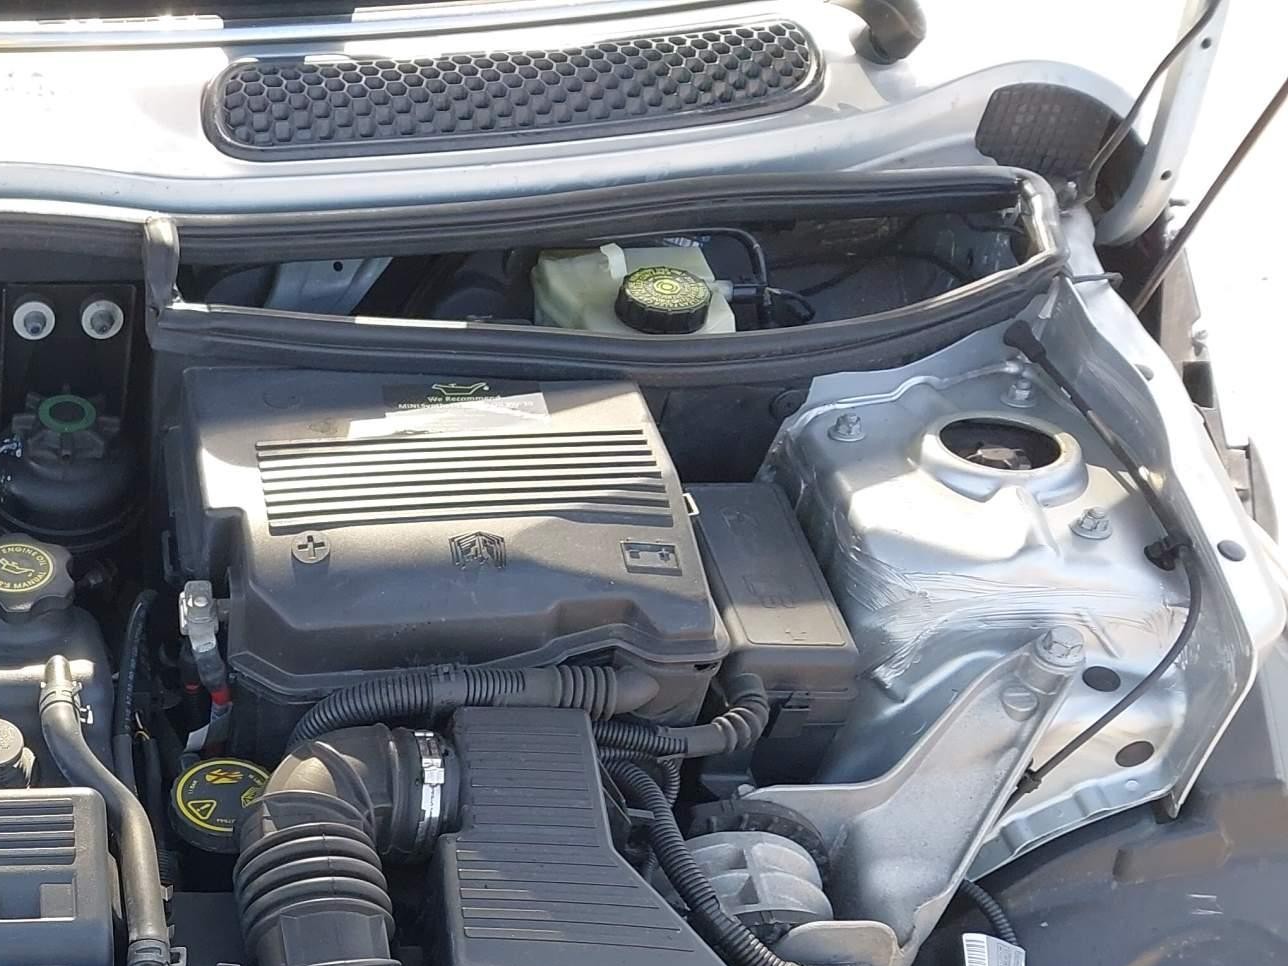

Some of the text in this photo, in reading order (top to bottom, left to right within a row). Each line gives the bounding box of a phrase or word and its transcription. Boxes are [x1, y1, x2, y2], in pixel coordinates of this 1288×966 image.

[1, 546, 48, 566] ENGINE OIL
[13, 571, 47, 589] MANUAL
